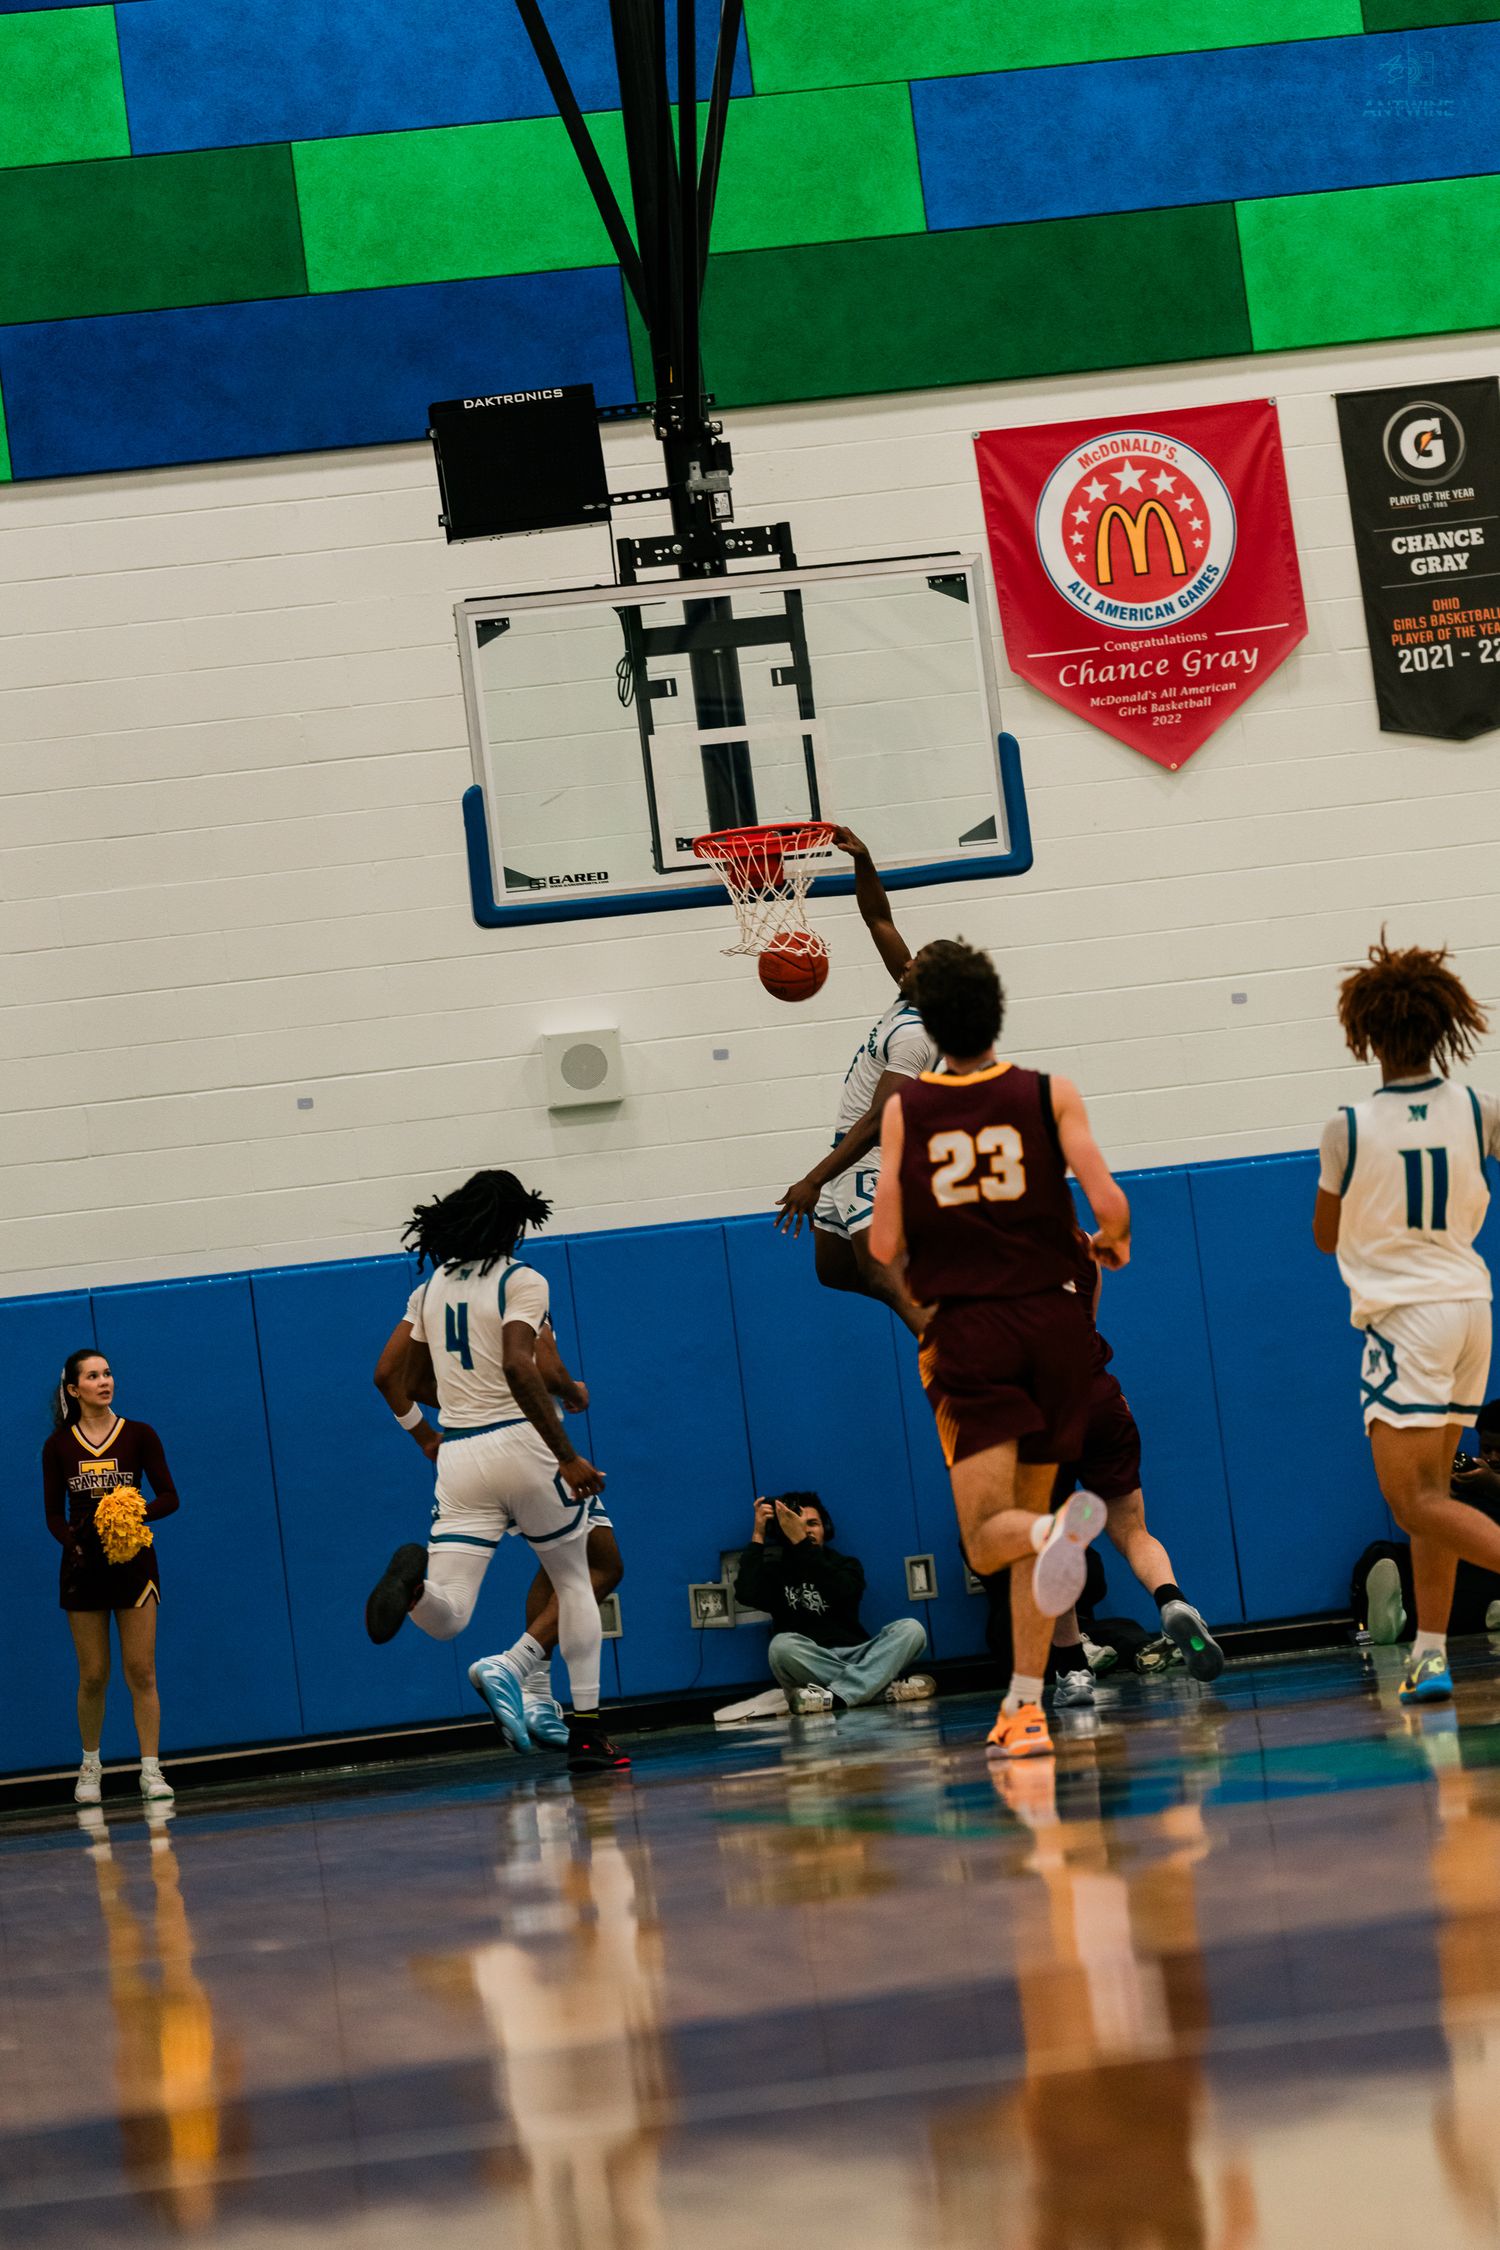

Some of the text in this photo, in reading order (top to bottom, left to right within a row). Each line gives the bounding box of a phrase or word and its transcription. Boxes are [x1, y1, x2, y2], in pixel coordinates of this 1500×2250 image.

[463, 388, 563, 409] DAKTRONICS
[1389, 487, 1475, 506] PLAYER OF THE YEAR
[1391, 527, 1485, 555] CHANCE
[1410, 552, 1470, 576] GRAY
[1067, 564, 1220, 621] ALL AMERICAN GAMES
[1432, 597, 1461, 612] OHIO
[1393, 616, 1427, 632] GIRLS
[1104, 632, 1208, 652] Congratulations
[1391, 631, 1434, 647] PLAYER
[1437, 628, 1452, 641] OF
[1455, 625, 1477, 639] THE
[1059, 647, 1259, 687] Chance Gray
[1398, 643, 1454, 674] 2021
[1090, 682, 1237, 707] McDonald's All American
[1119, 697, 1212, 717] Girls Basketball
[1152, 713, 1182, 726] 2022
[549, 871, 609, 884] GARED
[928, 1124, 1027, 1208] 23
[1398, 1147, 1449, 1231] 11
[445, 1302, 474, 1370] 4
[68, 1472, 134, 1492] SPARTANS
